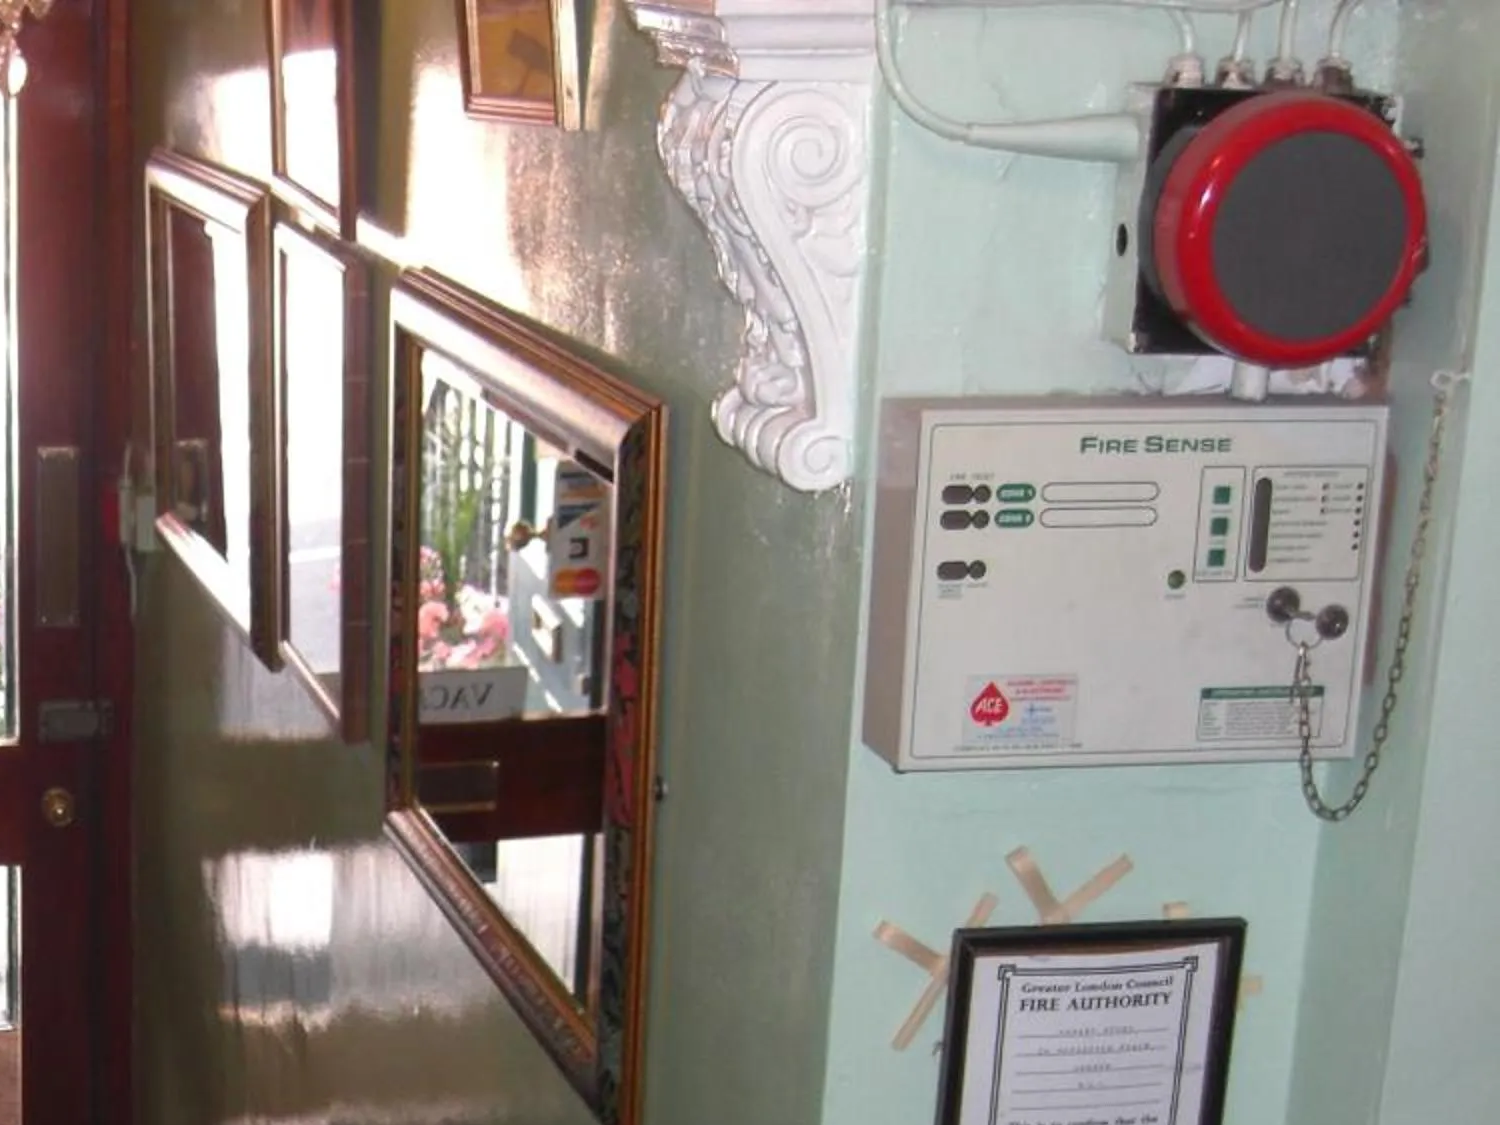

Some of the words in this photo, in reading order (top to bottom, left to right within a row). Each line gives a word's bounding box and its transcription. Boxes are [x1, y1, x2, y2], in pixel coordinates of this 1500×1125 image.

[1080, 436, 1139, 454] FIRE
[1145, 435, 1233, 453] SENSE
[975, 698, 1005, 713] ACE
[1021, 981, 1070, 993] Greater
[1075, 980, 1123, 993] London
[1126, 976, 1174, 990] Council
[1019, 998, 1061, 1012] FIRE
[1066, 992, 1172, 1011] AUTHORITY
